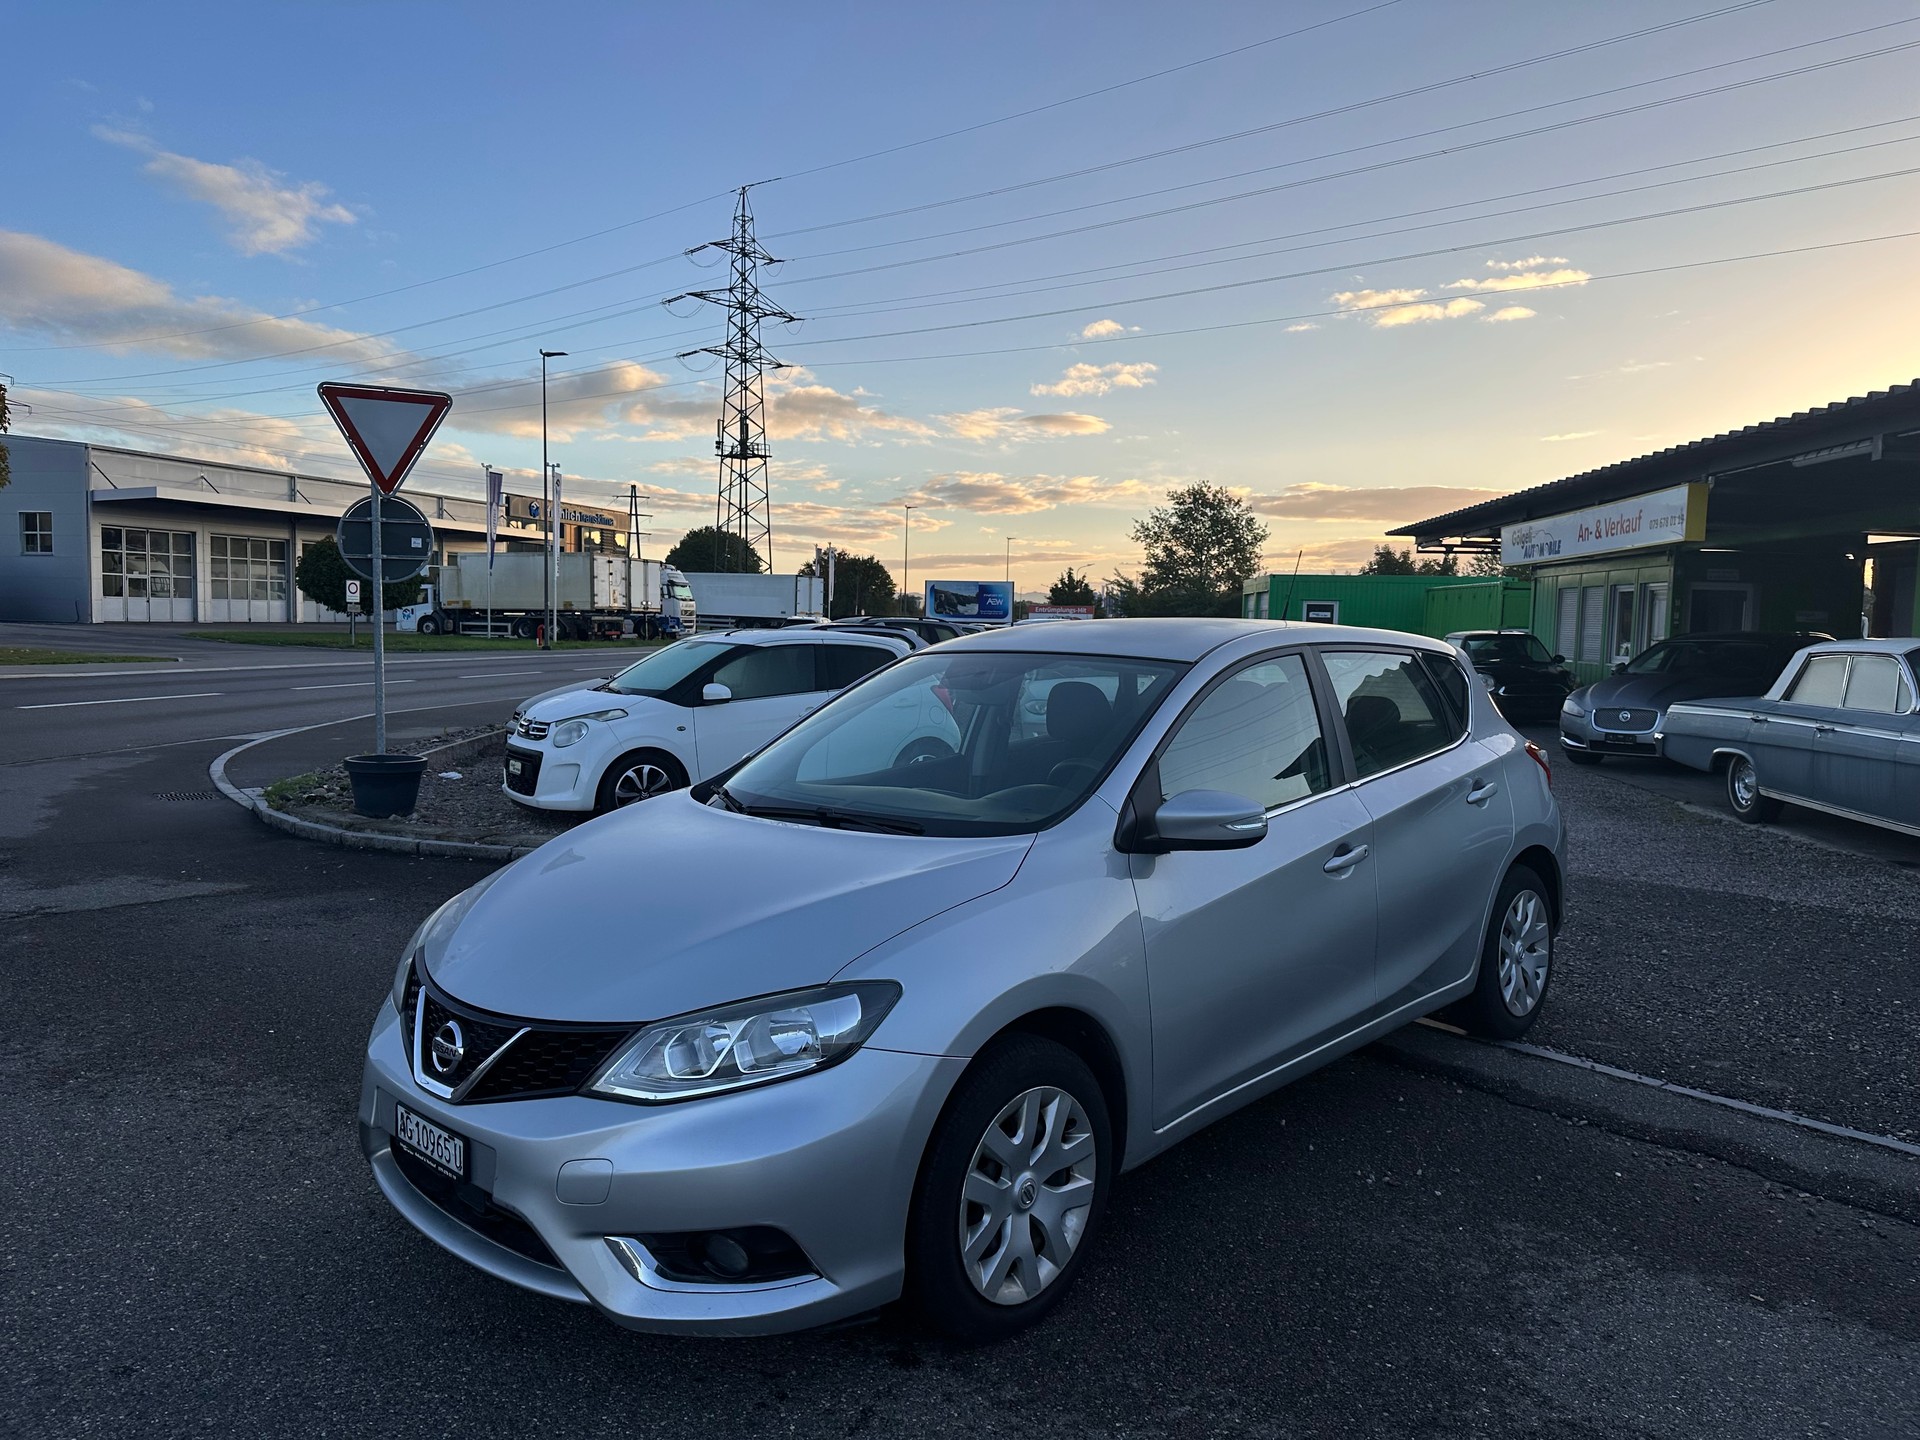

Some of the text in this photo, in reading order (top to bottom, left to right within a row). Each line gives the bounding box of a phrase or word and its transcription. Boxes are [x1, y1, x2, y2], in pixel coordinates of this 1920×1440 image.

[1577, 508, 1643, 543] An- & Verkauf
[1523, 539, 1562, 560] AUTOMOBILE
[986, 597, 1004, 606] AEW
[433, 1041, 458, 1058] SSAN
